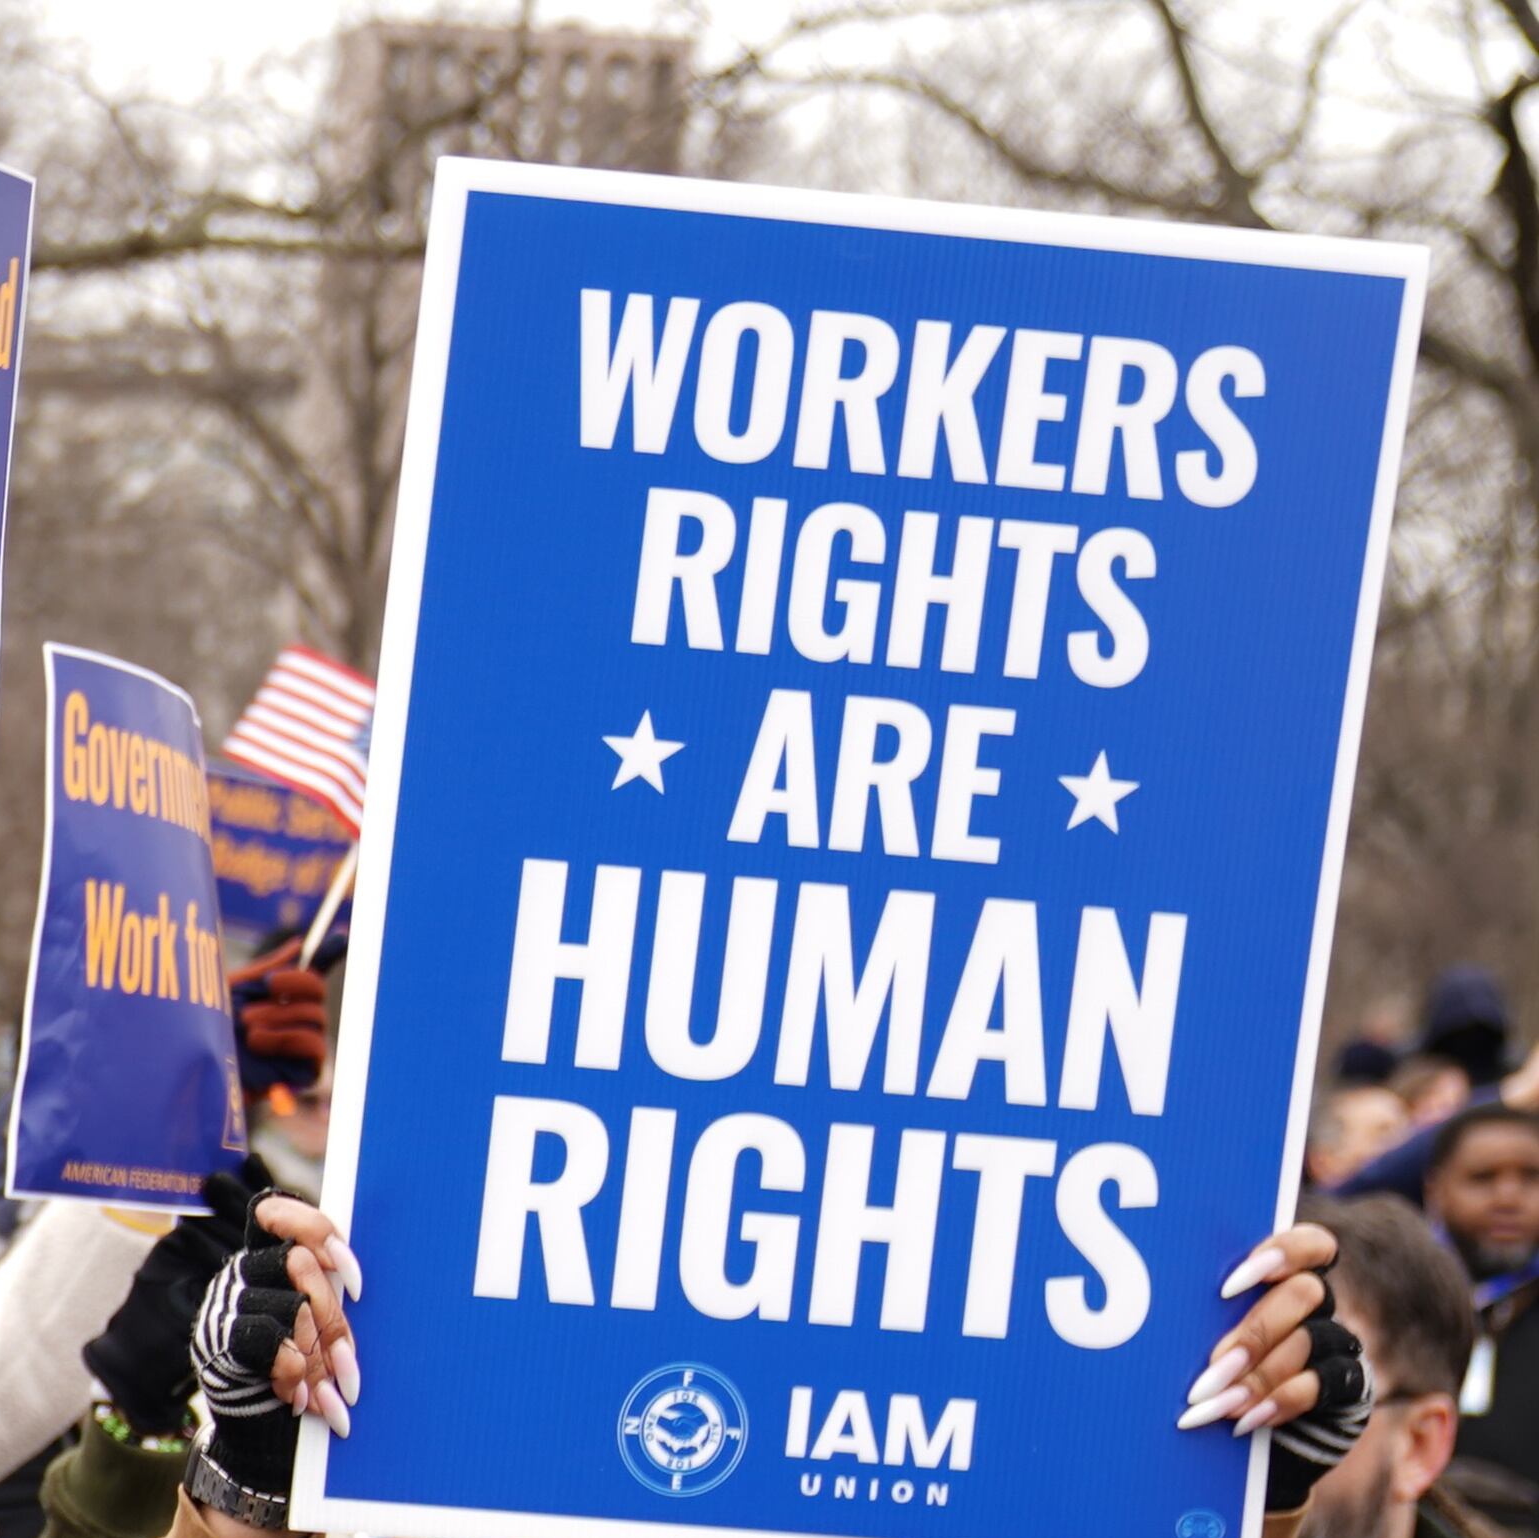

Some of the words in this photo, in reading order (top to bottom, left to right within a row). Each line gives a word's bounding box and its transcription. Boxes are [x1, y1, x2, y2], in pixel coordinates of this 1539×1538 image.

[580, 287, 1266, 508] WORKERS
[630, 487, 1158, 689] RIGHTS
[726, 689, 1017, 865] ARE
[86, 877, 179, 1001] Work
[501, 858, 1187, 1116] HUMAN
[61, 1160, 126, 1186] AMERICAN
[472, 1095, 1159, 1349] RIGHTS
[785, 1386, 977, 1471] IAM
[800, 1473, 949, 1506] UNION
